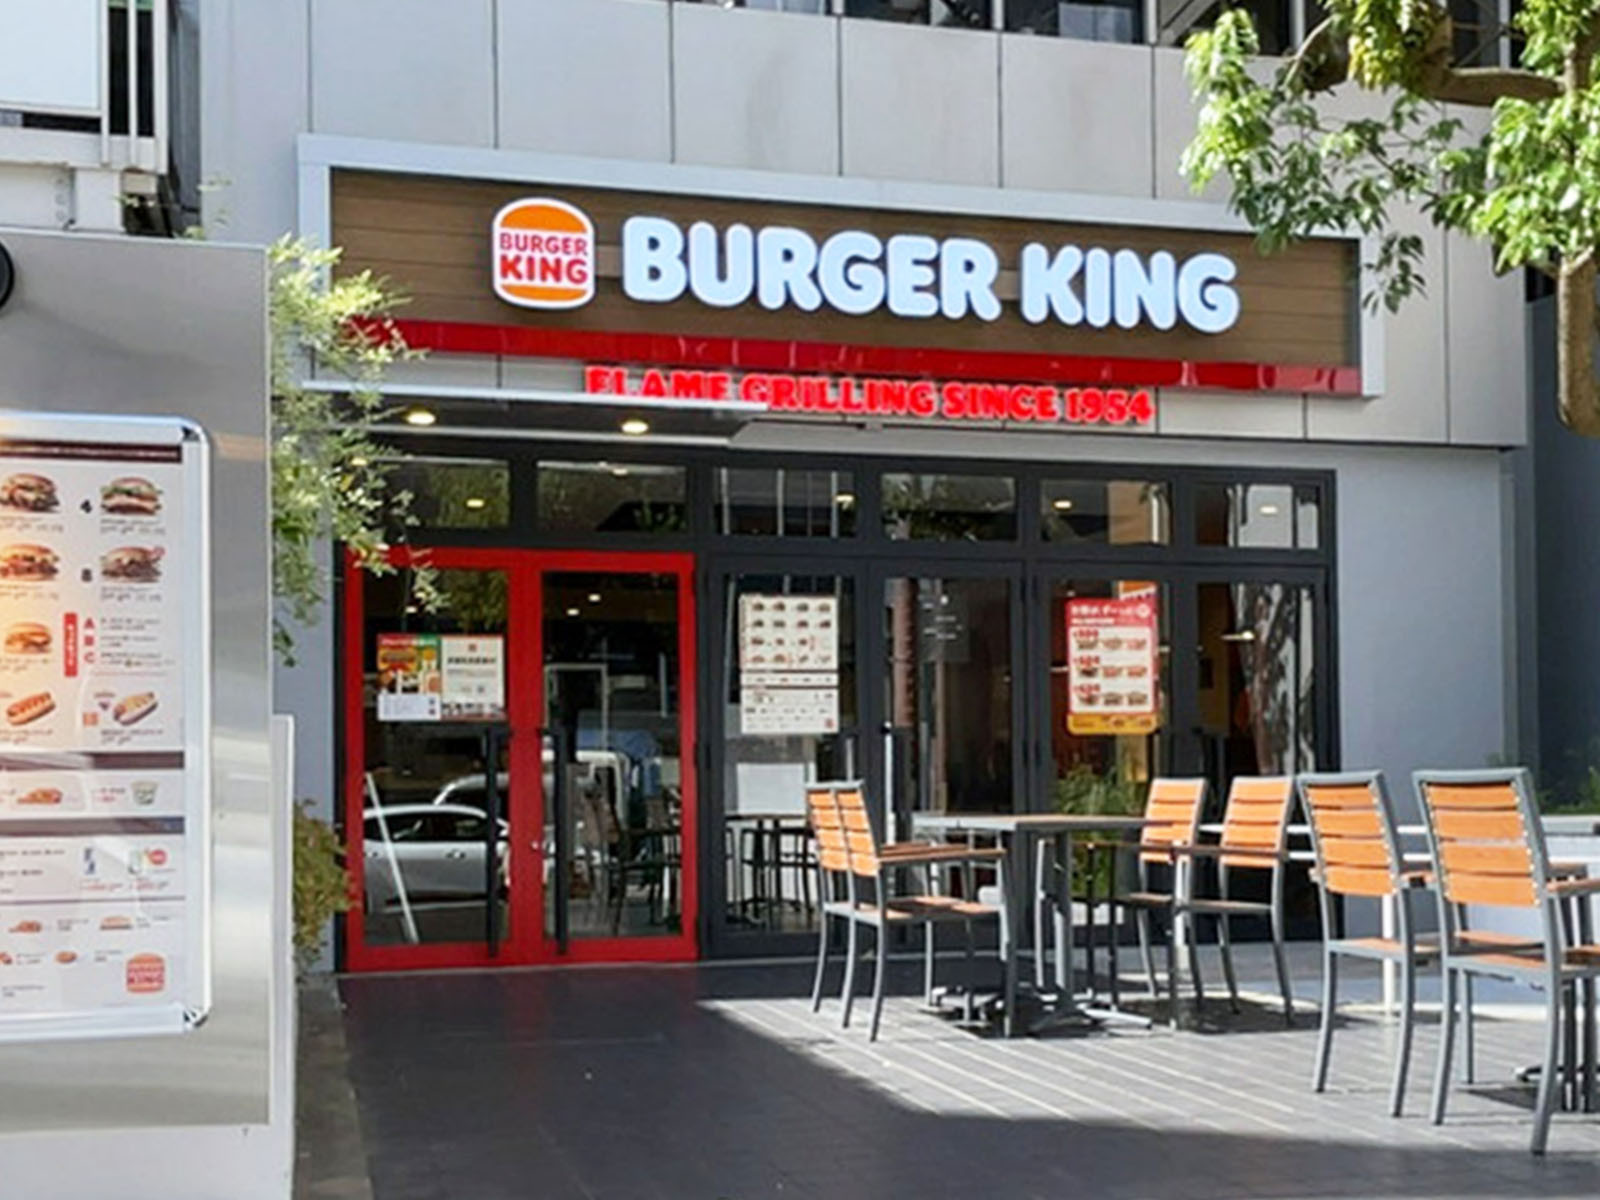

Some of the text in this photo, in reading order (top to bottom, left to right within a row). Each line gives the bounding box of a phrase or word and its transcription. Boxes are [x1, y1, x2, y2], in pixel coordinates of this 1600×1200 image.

[500, 232, 588, 257] BURGER
[501, 254, 588, 285] KING
[623, 216, 1240, 334] BURGER KING
[739, 373, 934, 416] GRILLING
[942, 382, 1058, 421] SINCE
[1065, 387, 1155, 424] 1954
